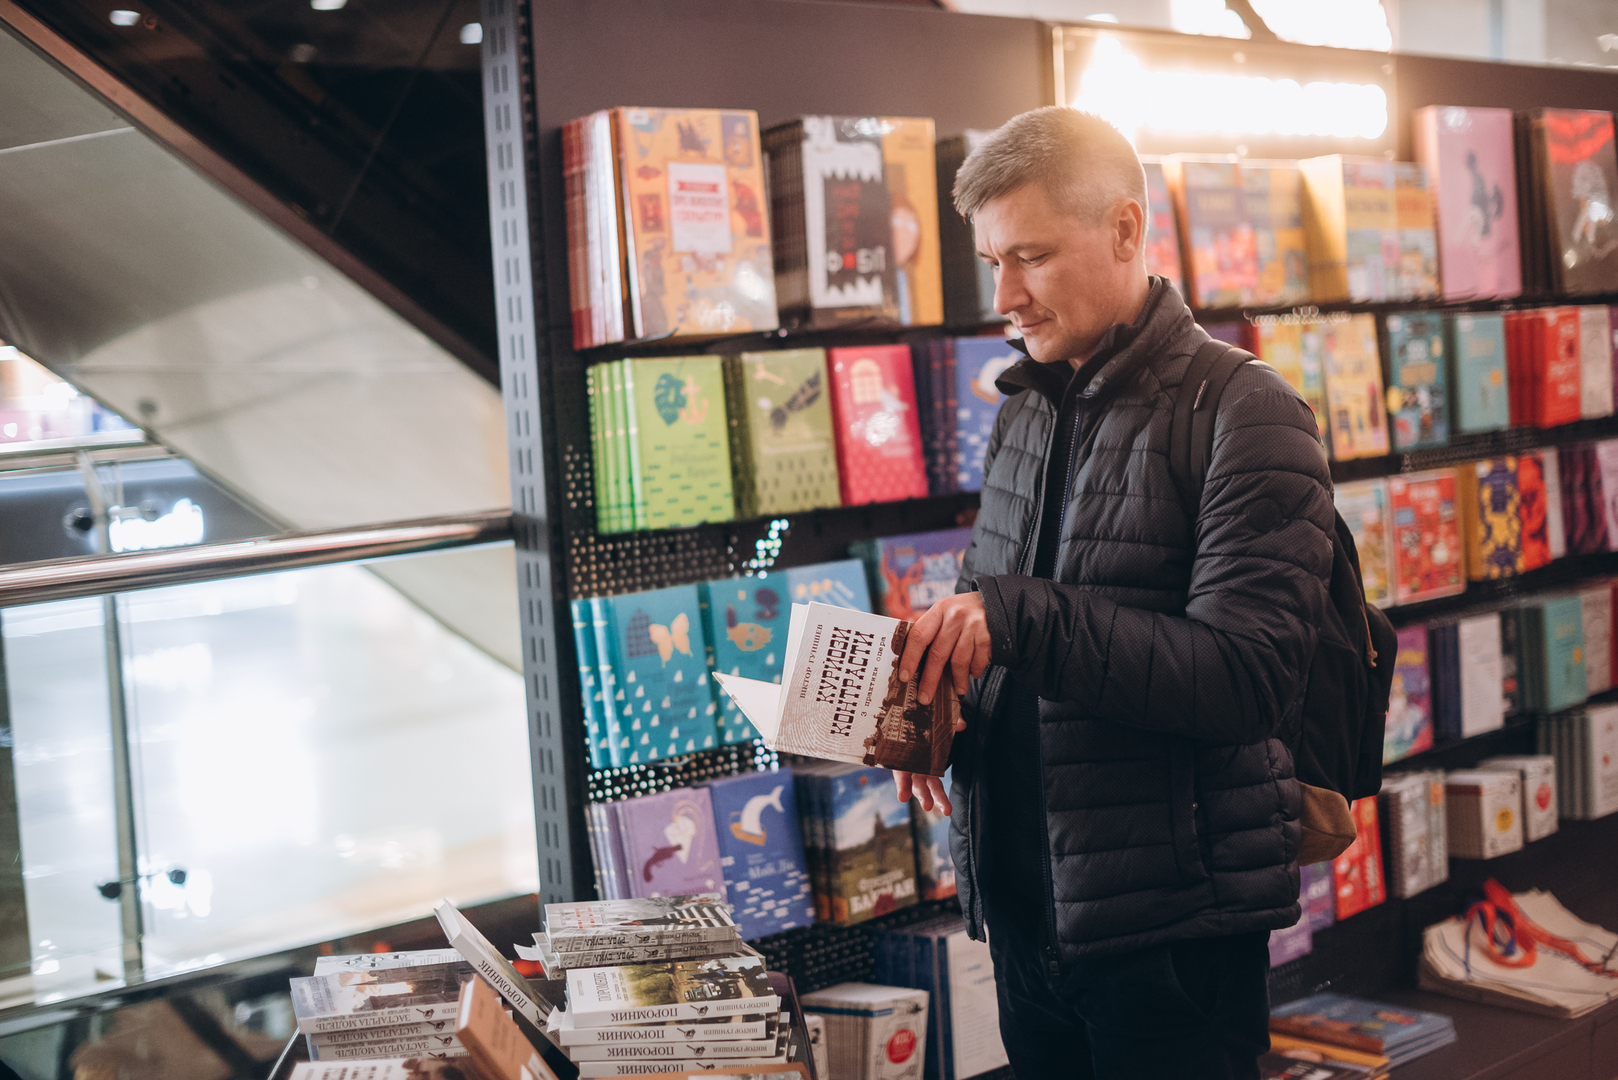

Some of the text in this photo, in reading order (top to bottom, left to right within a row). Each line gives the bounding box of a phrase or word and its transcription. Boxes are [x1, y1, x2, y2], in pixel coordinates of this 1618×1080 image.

[815, 626, 852, 705] КУРЙОЗИ
[864, 666, 880, 707] практики
[875, 636, 887, 662] опера
[799, 665, 813, 699] ВІКТОР
[829, 630, 875, 737] КОНТРАСТИ
[477, 959, 528, 1009] ПОРОМНИК
[315, 1013, 411, 1031] ЗАСТАРІЛА МОДЕЛЬ
[610, 1007, 678, 1022] ПОРОМНИК
[326, 1026, 422, 1043] ЗАСТАРІЛА МОДЕЛЬ
[596, 1028, 665, 1041] ПОРОМНИК
[334, 1046, 376, 1059] МОДЕЛЬ
[377, 1041, 430, 1054] ЗАСТАРІЛА
[606, 1045, 674, 1057] ПОРОМНИК
[616, 1063, 684, 1075] ПОРОМНИК
